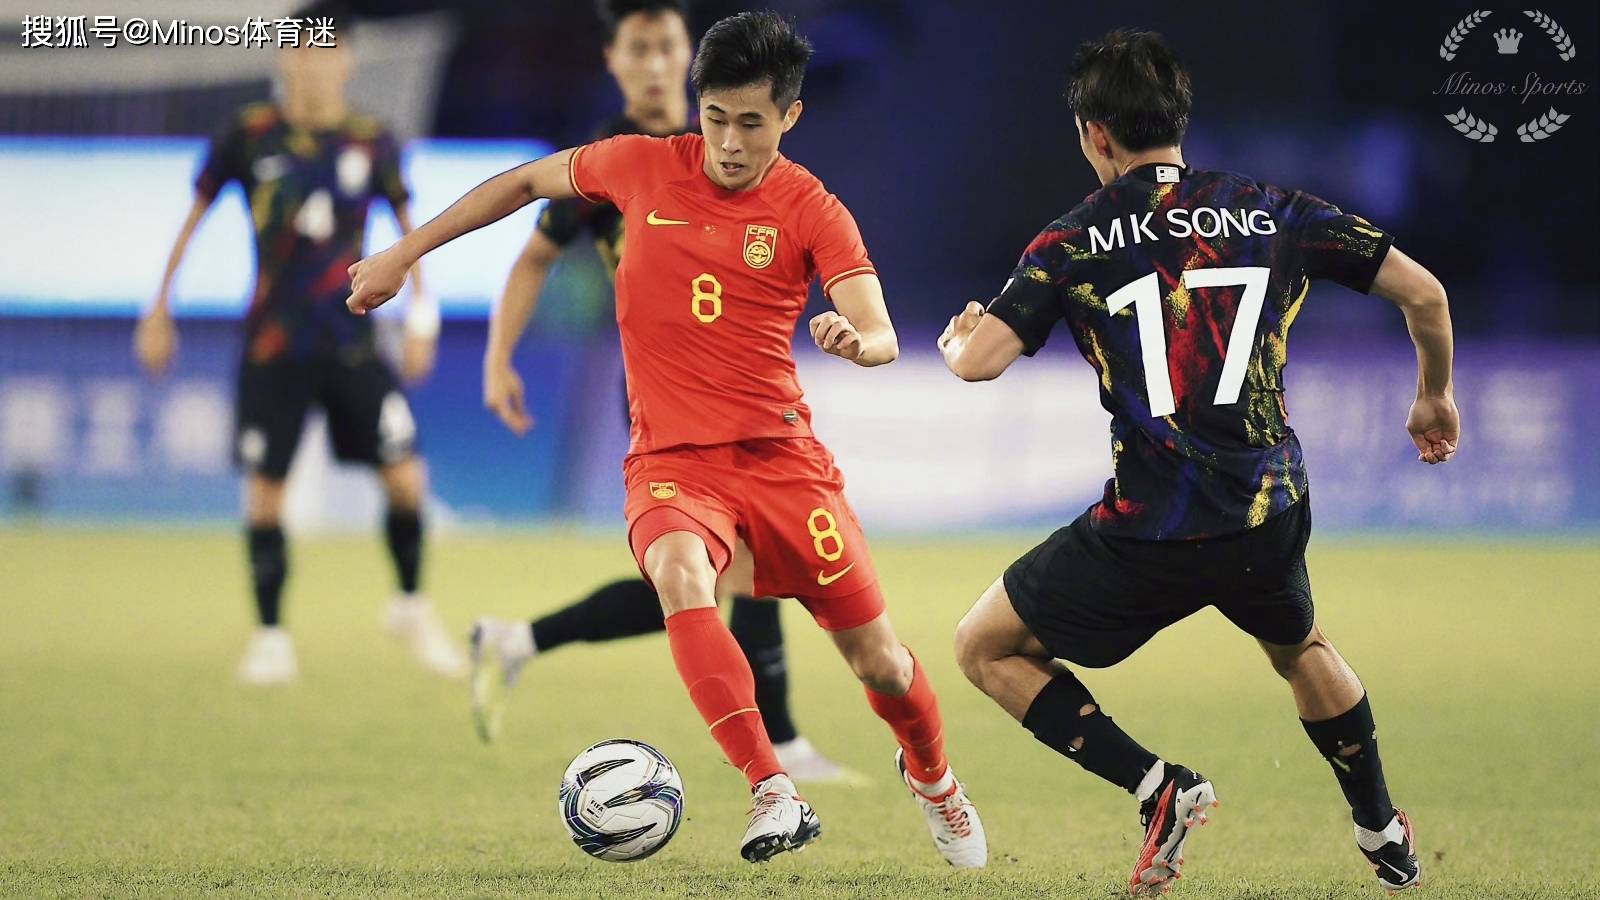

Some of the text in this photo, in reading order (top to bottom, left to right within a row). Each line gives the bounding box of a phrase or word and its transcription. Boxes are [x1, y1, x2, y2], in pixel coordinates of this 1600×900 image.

[748, 226, 775, 238] CFA
[1166, 207, 1278, 239] SONG
[691, 272, 722, 323] 8
[1105, 266, 1271, 418] 17
[807, 507, 845, 562] 8
[590, 799, 604, 812] FIFA
